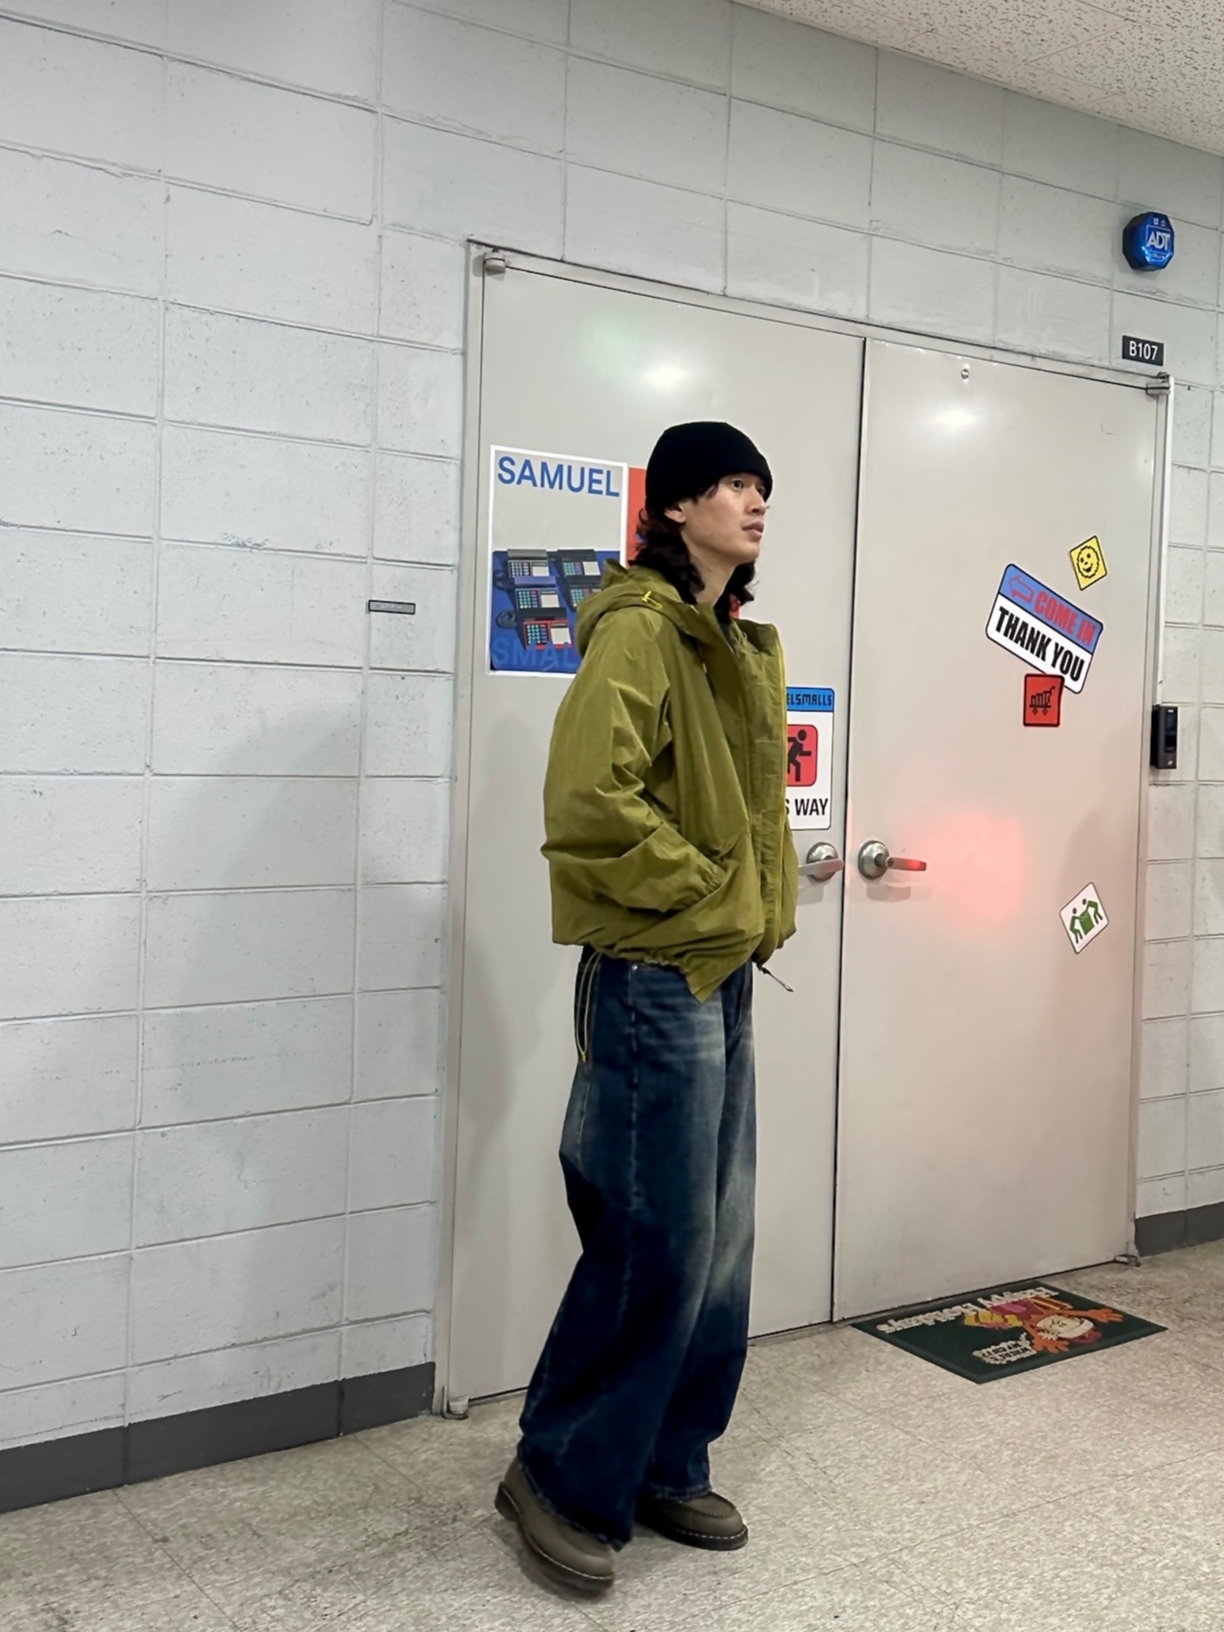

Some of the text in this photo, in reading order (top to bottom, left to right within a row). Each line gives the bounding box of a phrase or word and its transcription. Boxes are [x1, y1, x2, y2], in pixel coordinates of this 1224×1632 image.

[1146, 231, 1170, 250] ADT
[1129, 340, 1158, 360] B107
[498, 456, 620, 497] SAMUEL
[1034, 591, 1097, 646] COME IN
[492, 638, 578, 668] SMAL
[995, 606, 1085, 682] THANK YOU
[786, 693, 832, 706] ELSMALLS
[795, 798, 828, 816] WAY
[876, 1286, 1059, 1334] Happy Holidays
